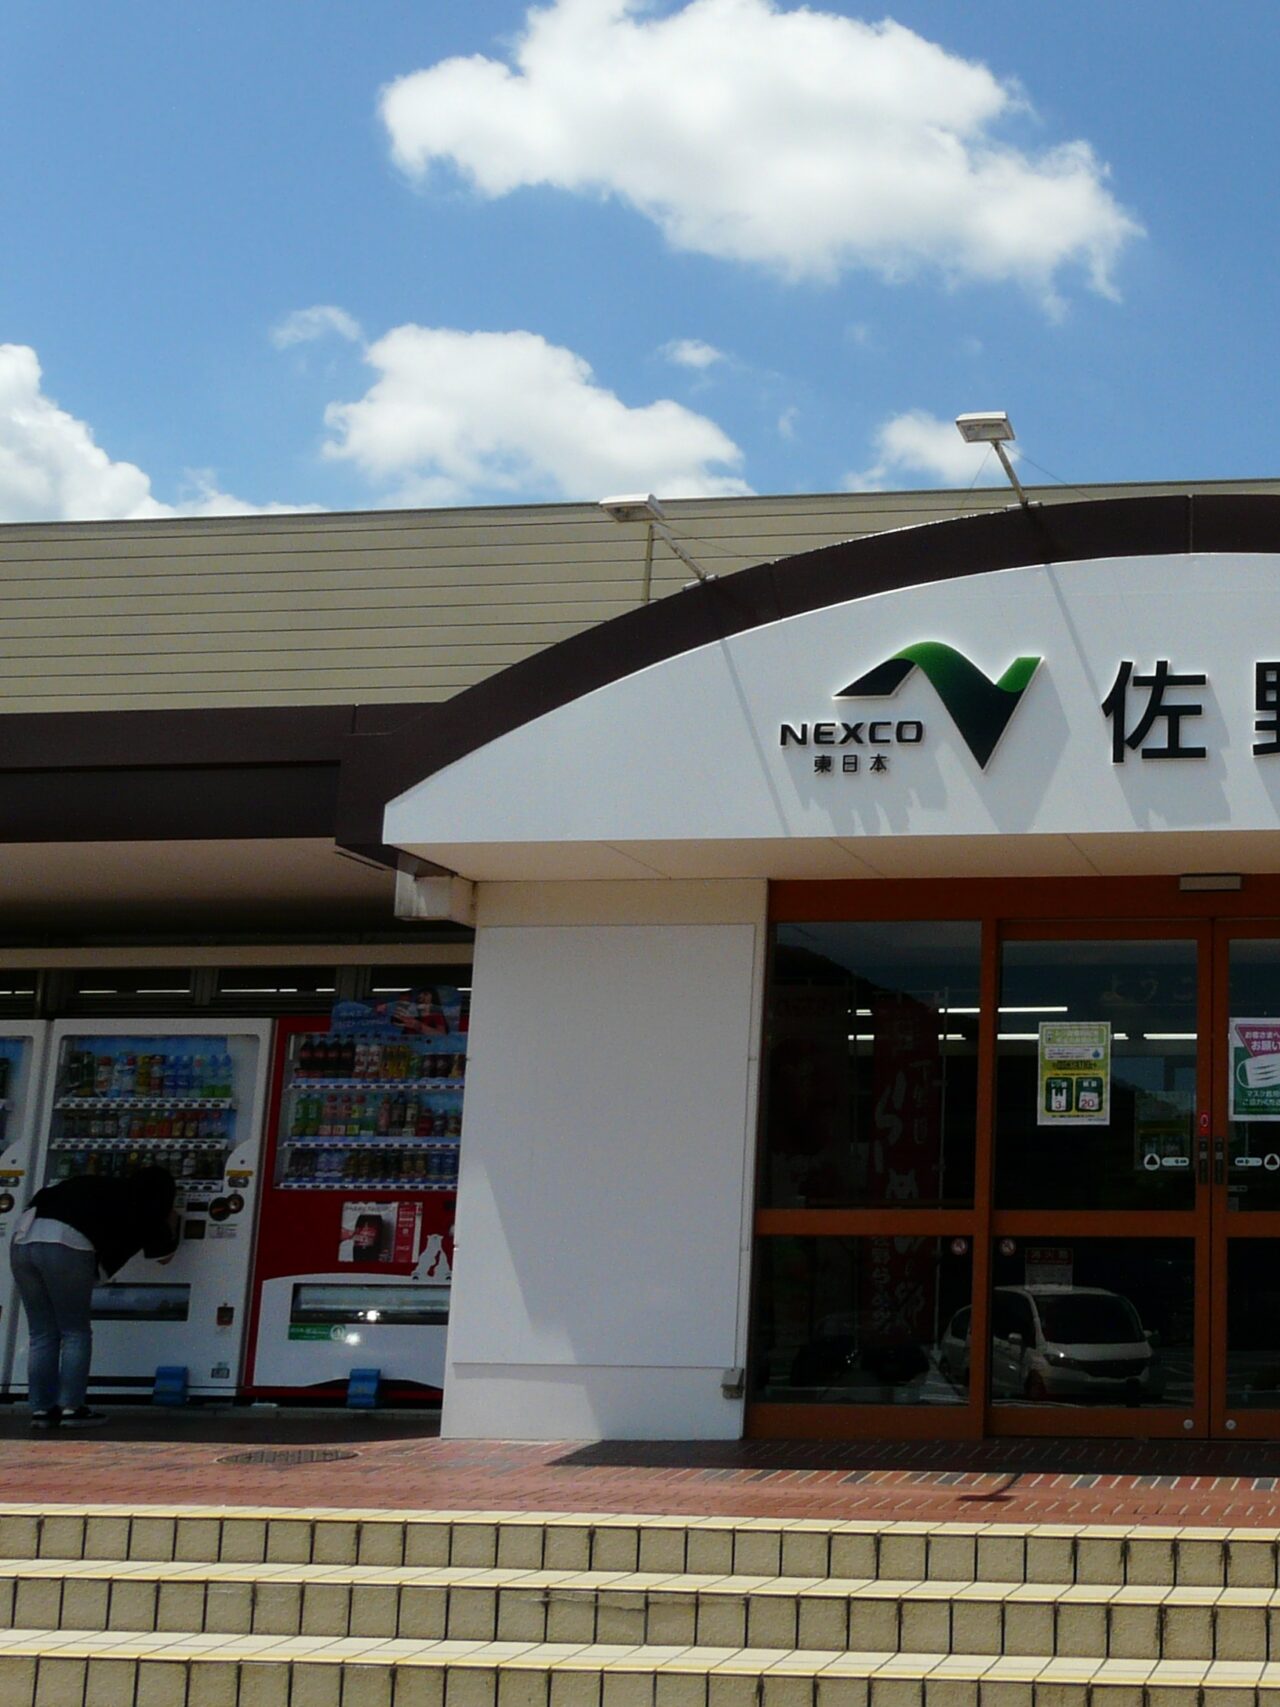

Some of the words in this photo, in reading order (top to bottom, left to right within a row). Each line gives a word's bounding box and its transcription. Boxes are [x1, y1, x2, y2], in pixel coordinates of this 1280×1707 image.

[780, 720, 924, 746] NEXCO
[813, 754, 889, 774] 東日本
[1081, 1099, 1095, 1108] 20
